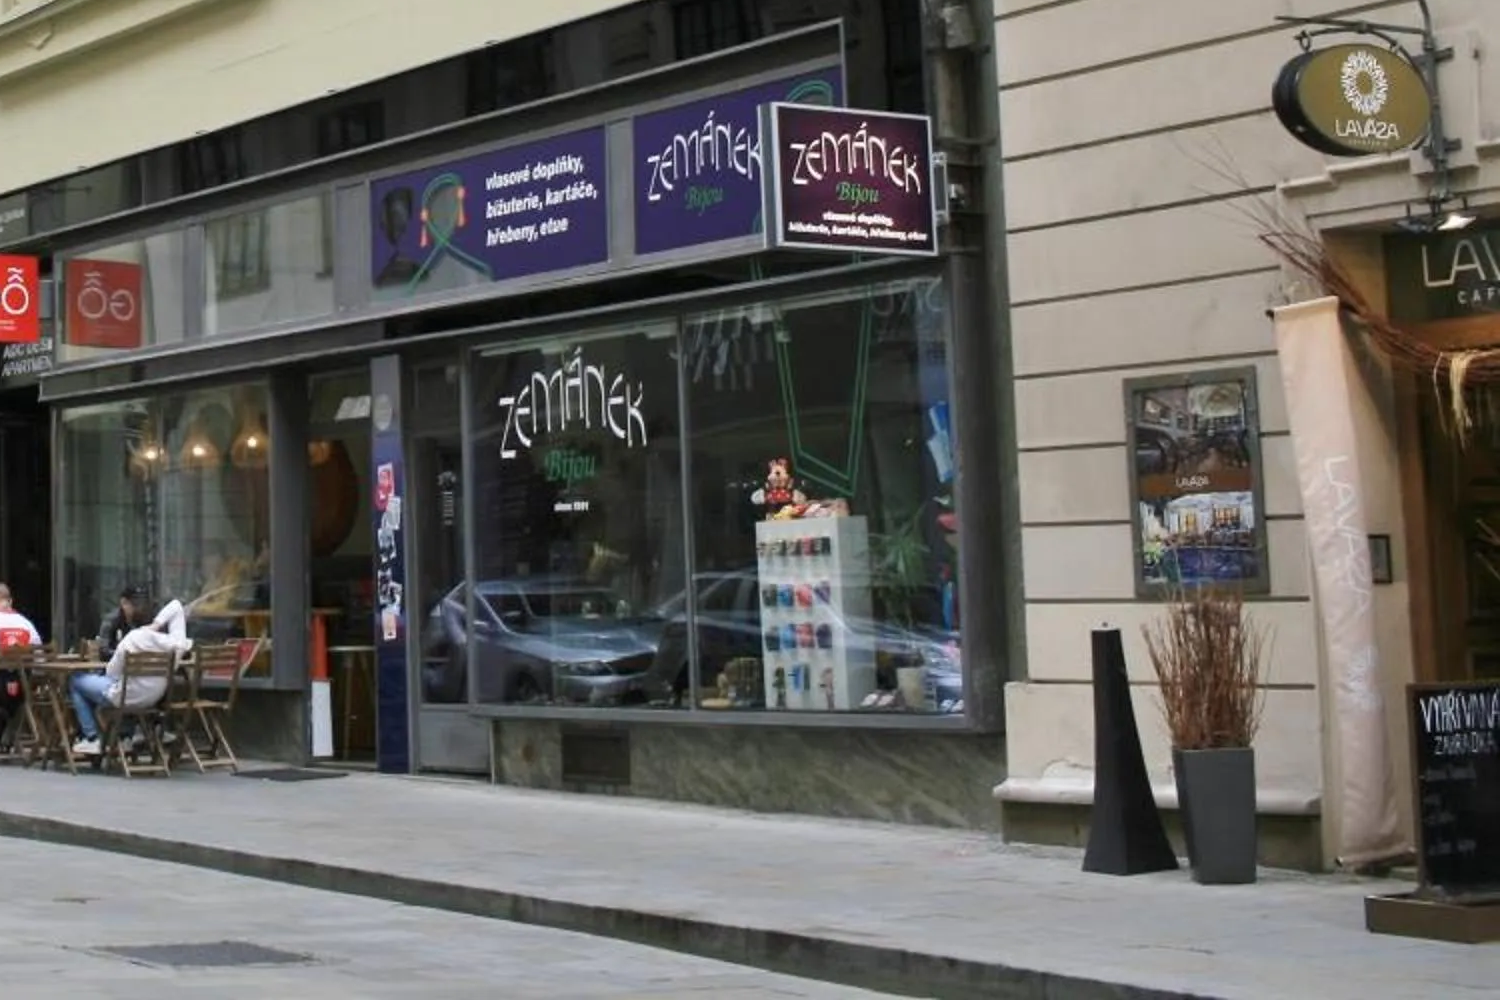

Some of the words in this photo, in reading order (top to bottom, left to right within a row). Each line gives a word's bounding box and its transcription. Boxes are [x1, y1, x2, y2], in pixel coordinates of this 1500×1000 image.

[485, 163, 531, 191] vlasové
[531, 153, 584, 181] doplňky,
[789, 121, 922, 195] ZEMÁNEK
[485, 191, 543, 219] bižuterie,
[545, 179, 598, 206] kartáče,
[835, 181, 881, 208] Bijou
[485, 223, 539, 247] hřebeny,
[540, 217, 569, 236] etue
[498, 346, 648, 459] ZEMÁNEK
